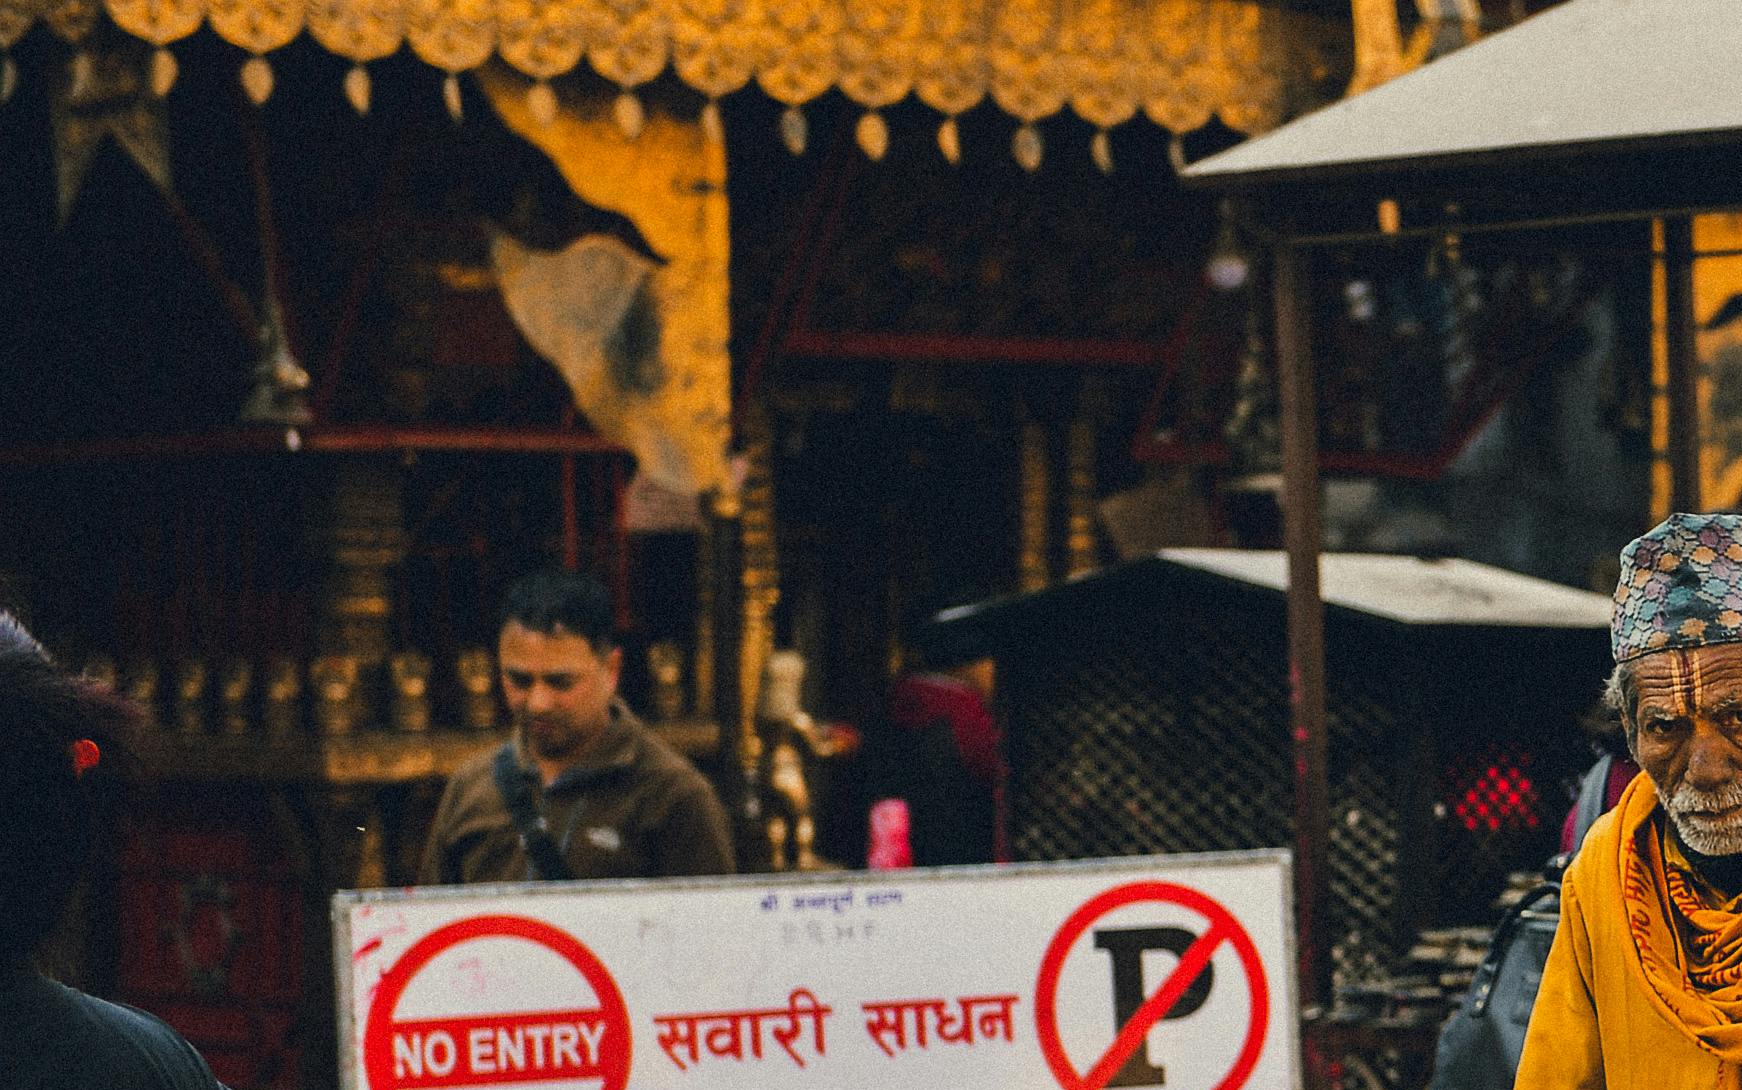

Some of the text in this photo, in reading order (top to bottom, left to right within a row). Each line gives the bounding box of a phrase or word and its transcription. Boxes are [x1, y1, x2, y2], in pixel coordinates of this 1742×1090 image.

[393, 1019, 606, 1079] NO ENTRY
[653, 987, 1020, 1070] सवारी साधन
[1093, 926, 1215, 1089] P
